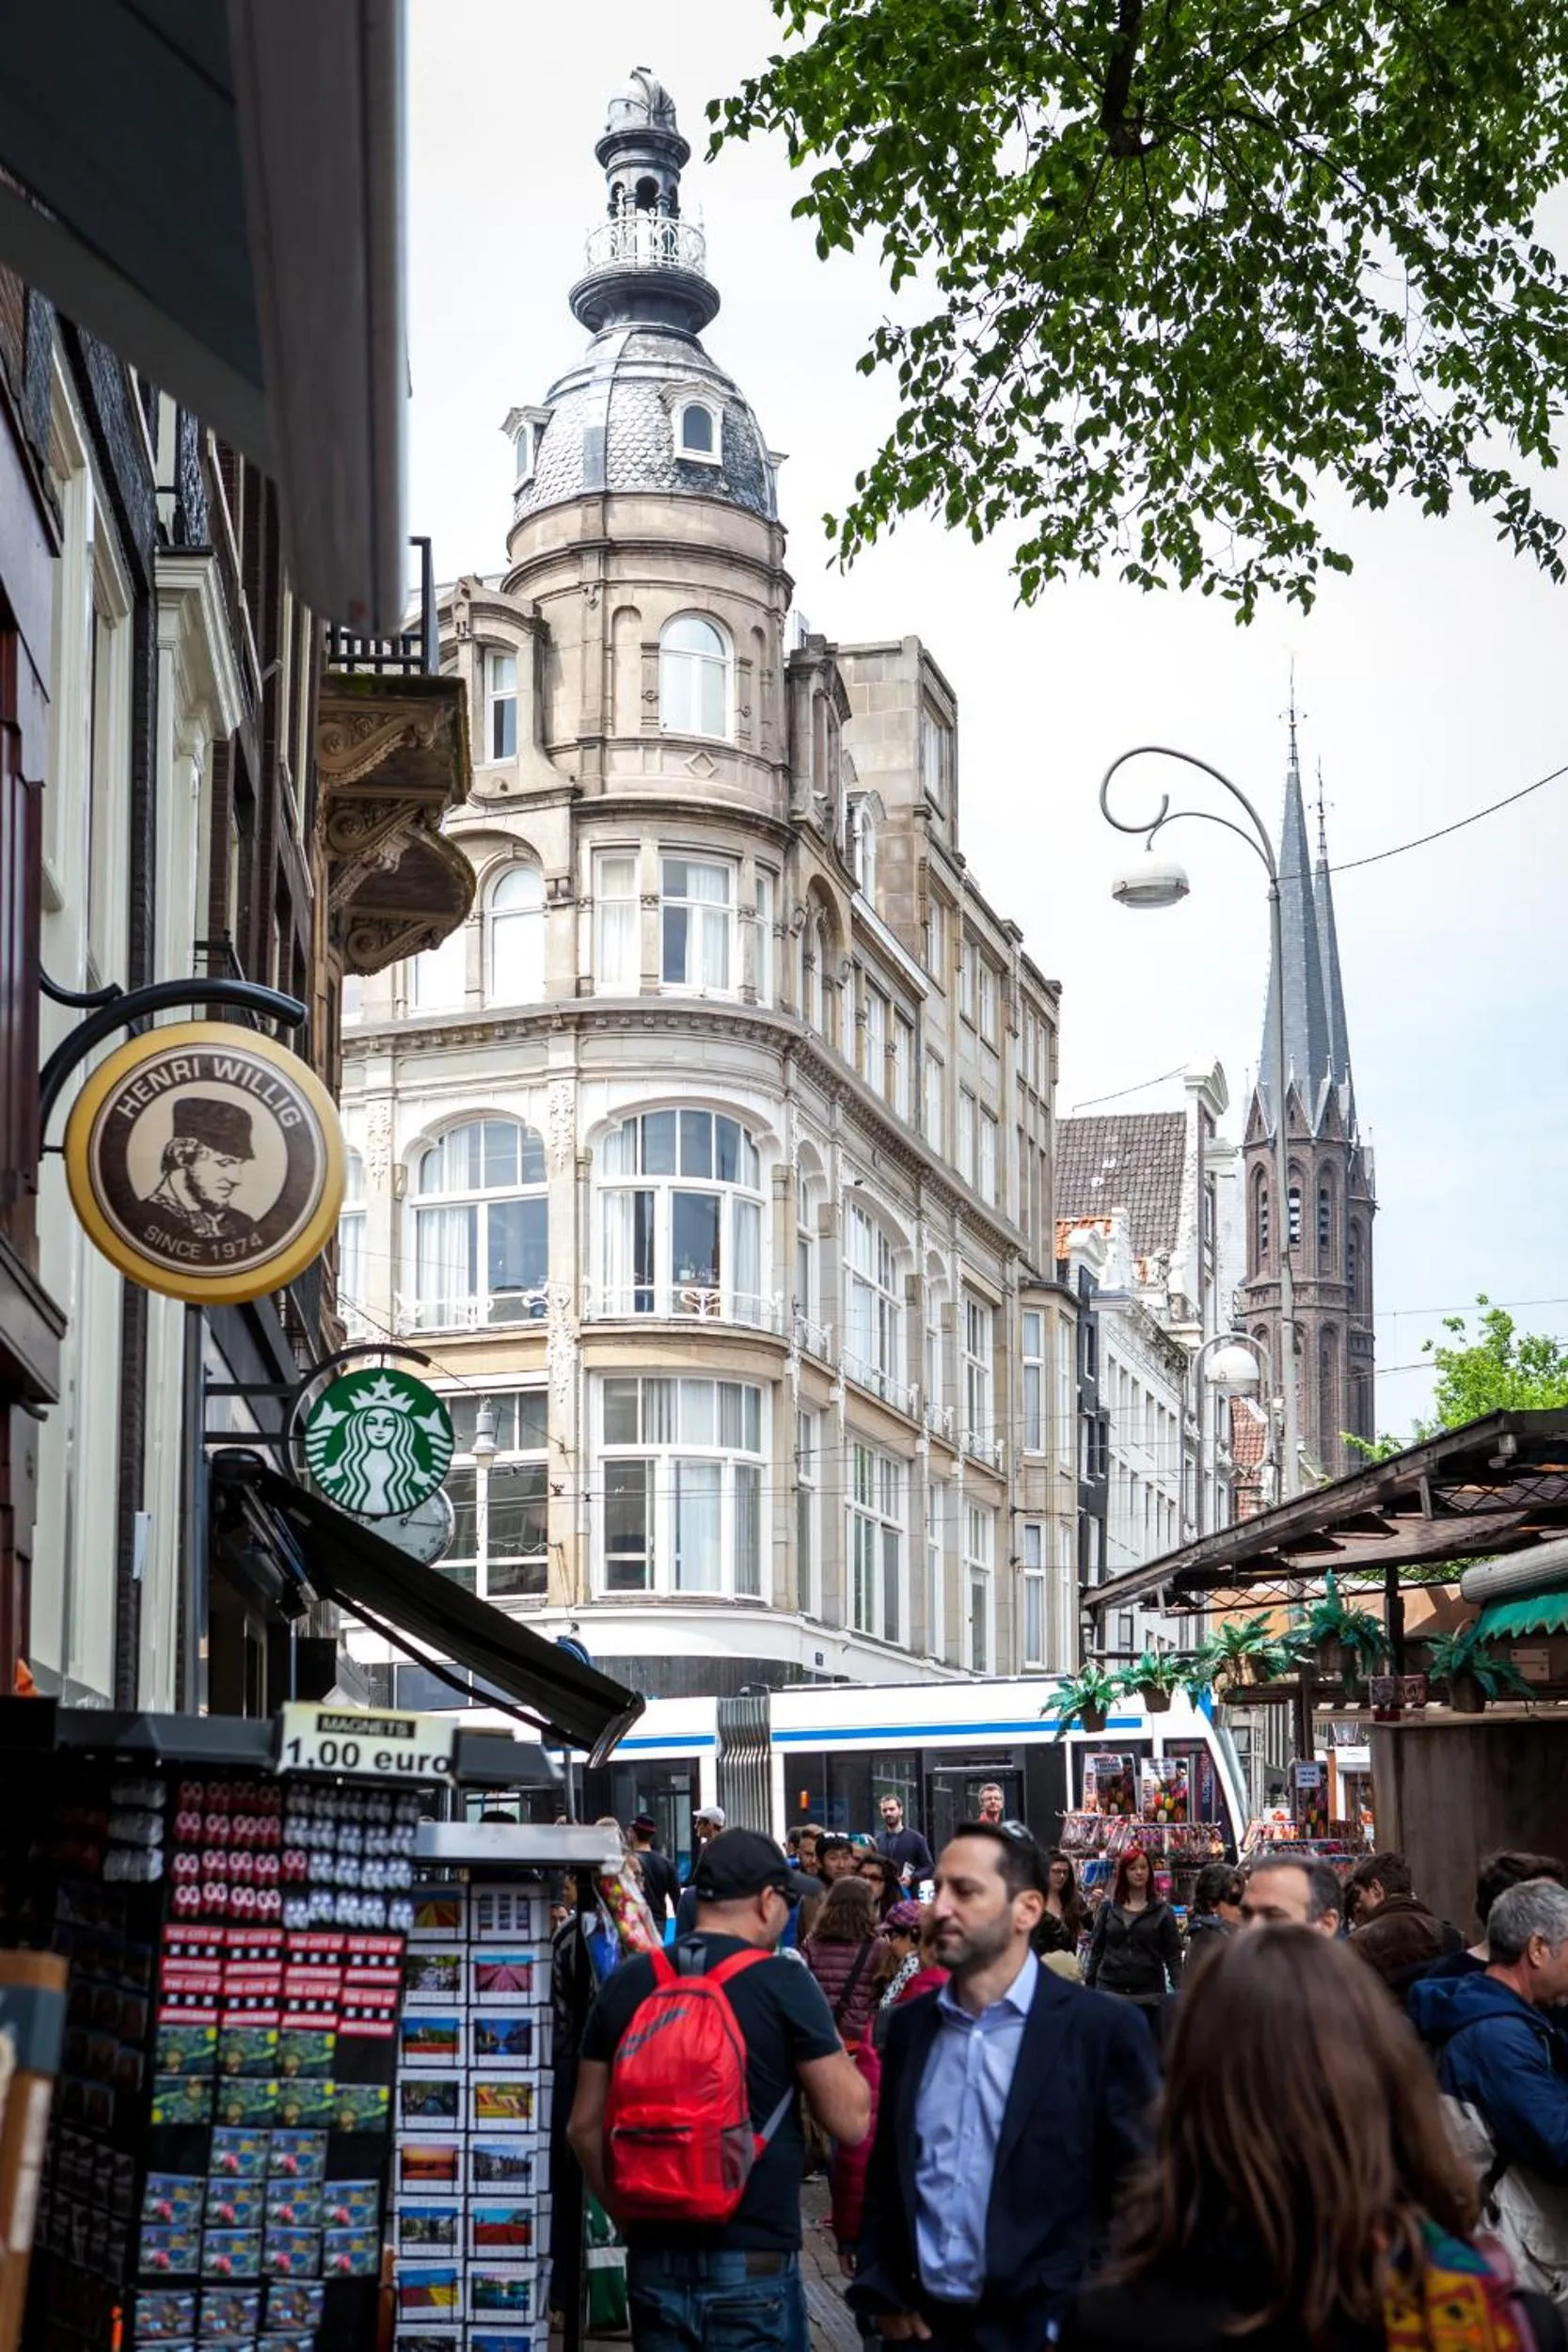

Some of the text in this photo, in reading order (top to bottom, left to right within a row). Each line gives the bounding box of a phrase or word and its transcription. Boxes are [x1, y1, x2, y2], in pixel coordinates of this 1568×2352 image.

[117, 1057, 302, 1128] HENRI WILLIG
[143, 1225, 263, 1260] SINCE 1974
[323, 1716, 409, 1737] MAGNETS
[373, 1752, 453, 1773] euro
